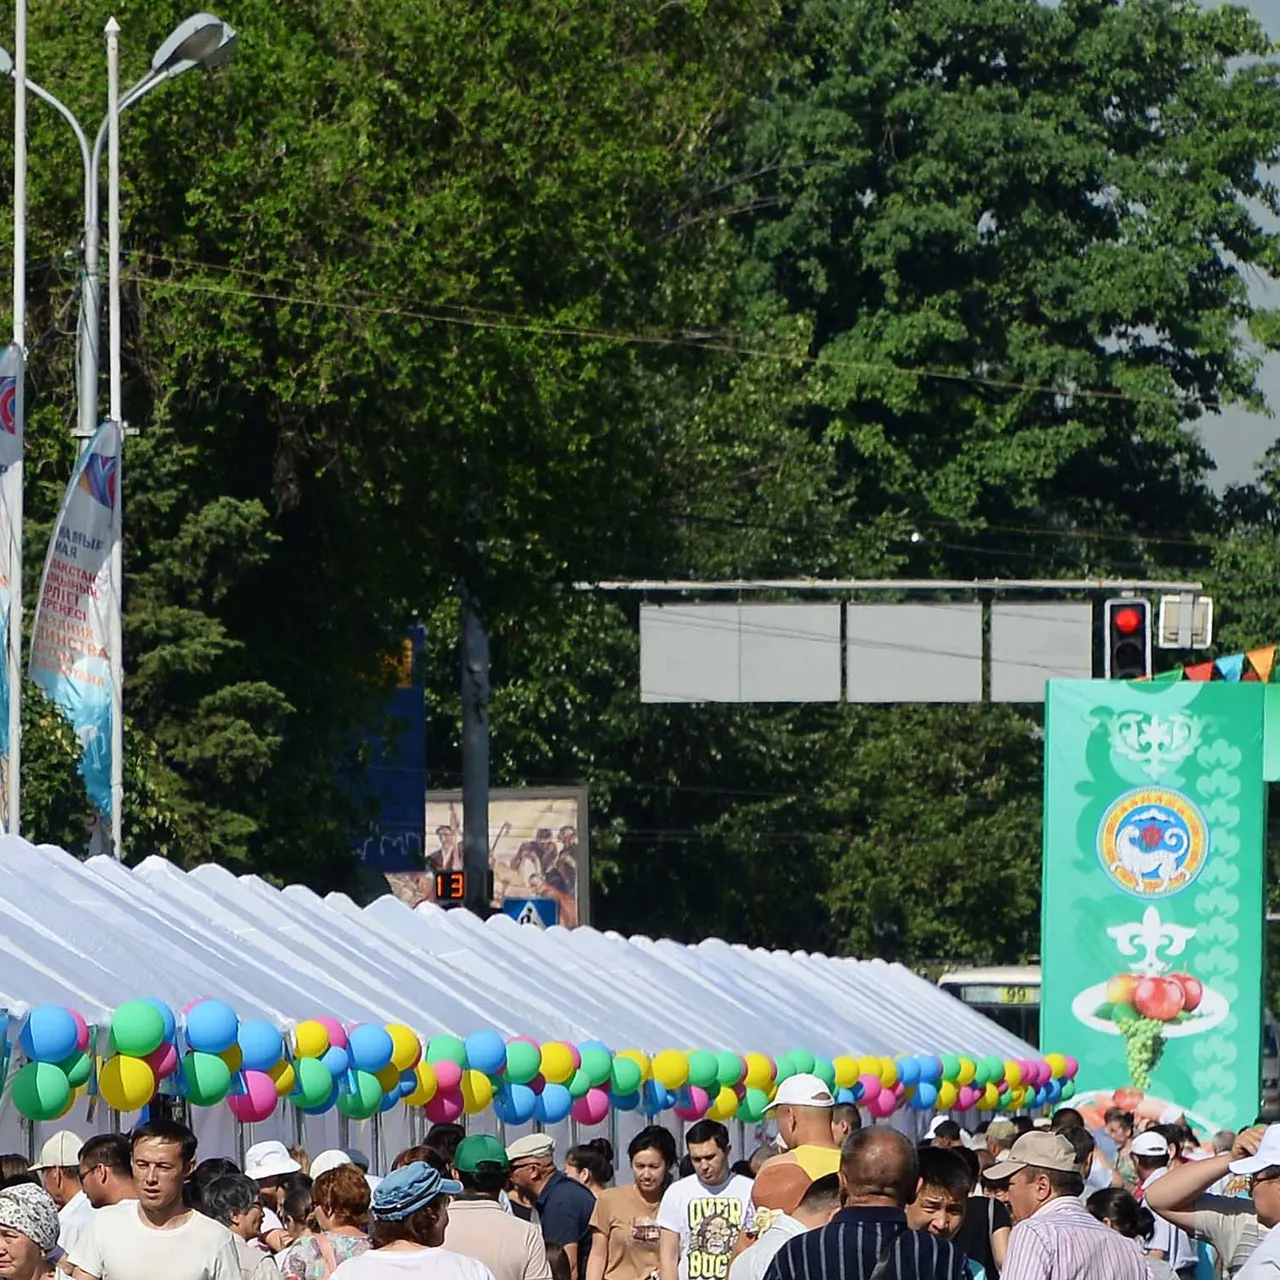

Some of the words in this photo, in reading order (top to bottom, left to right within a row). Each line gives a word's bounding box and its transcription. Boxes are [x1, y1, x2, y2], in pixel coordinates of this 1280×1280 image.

[437, 874, 464, 897] 13
[1007, 987, 1028, 1003] 99
[688, 1198, 742, 1231] OVER
[688, 1250, 732, 1280] BUC
